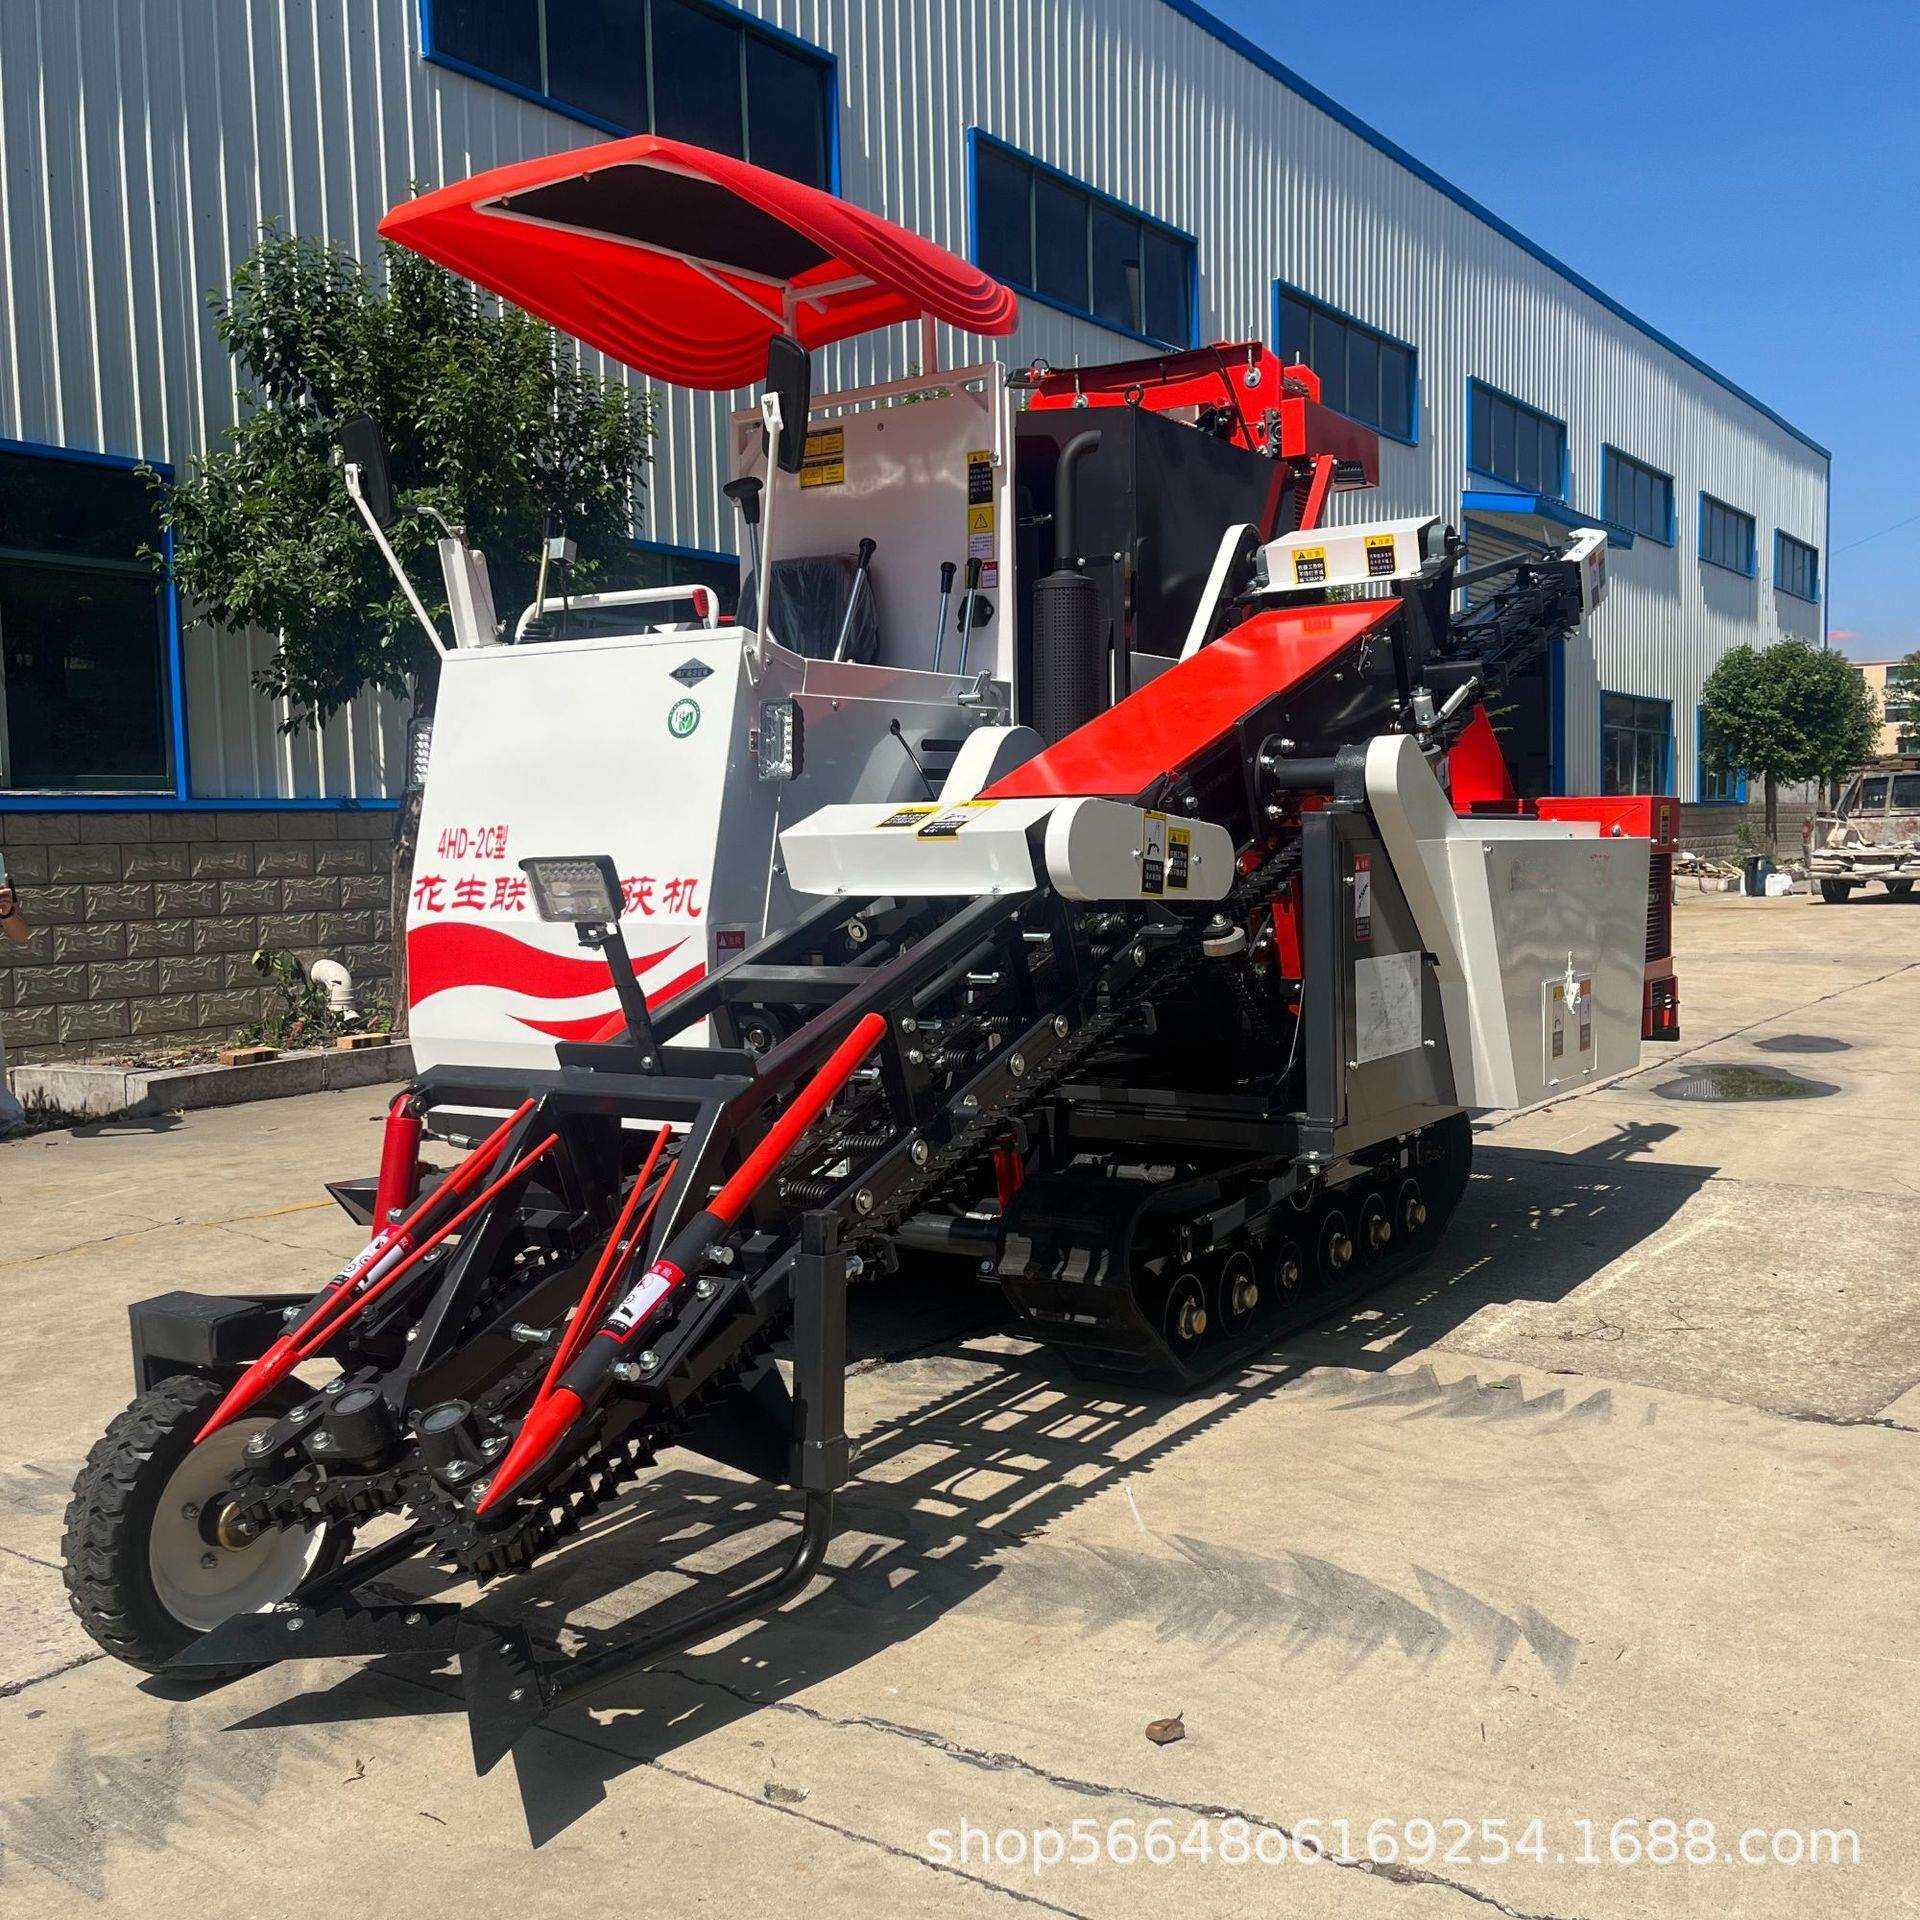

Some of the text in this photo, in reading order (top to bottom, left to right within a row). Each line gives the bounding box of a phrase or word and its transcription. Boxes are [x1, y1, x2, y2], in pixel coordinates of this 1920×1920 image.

[437, 824, 509, 859] 4HD-2C型
[413, 873, 702, 918] 花生联获机
